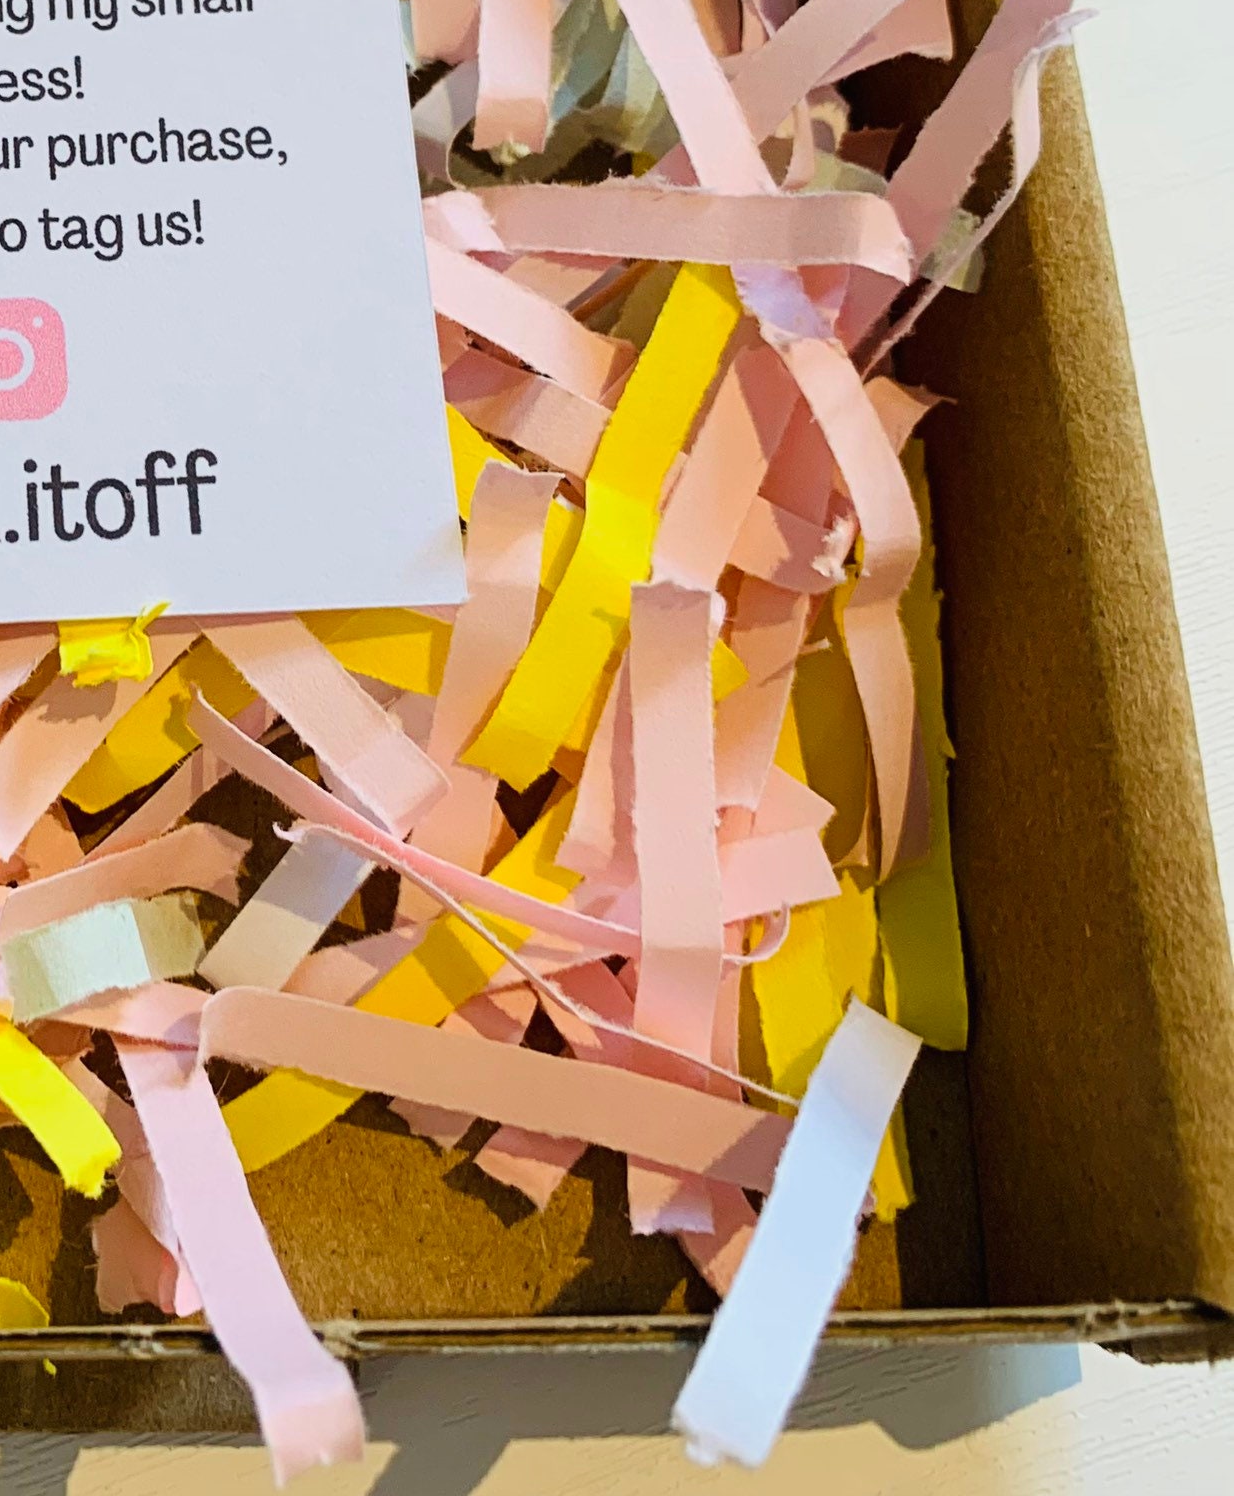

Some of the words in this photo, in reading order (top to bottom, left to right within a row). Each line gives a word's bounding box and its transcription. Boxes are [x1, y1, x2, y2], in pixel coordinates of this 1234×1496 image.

[48, 118, 287, 180] purchase,
[38, 208, 123, 261] tag
[137, 199, 204, 246] us!
